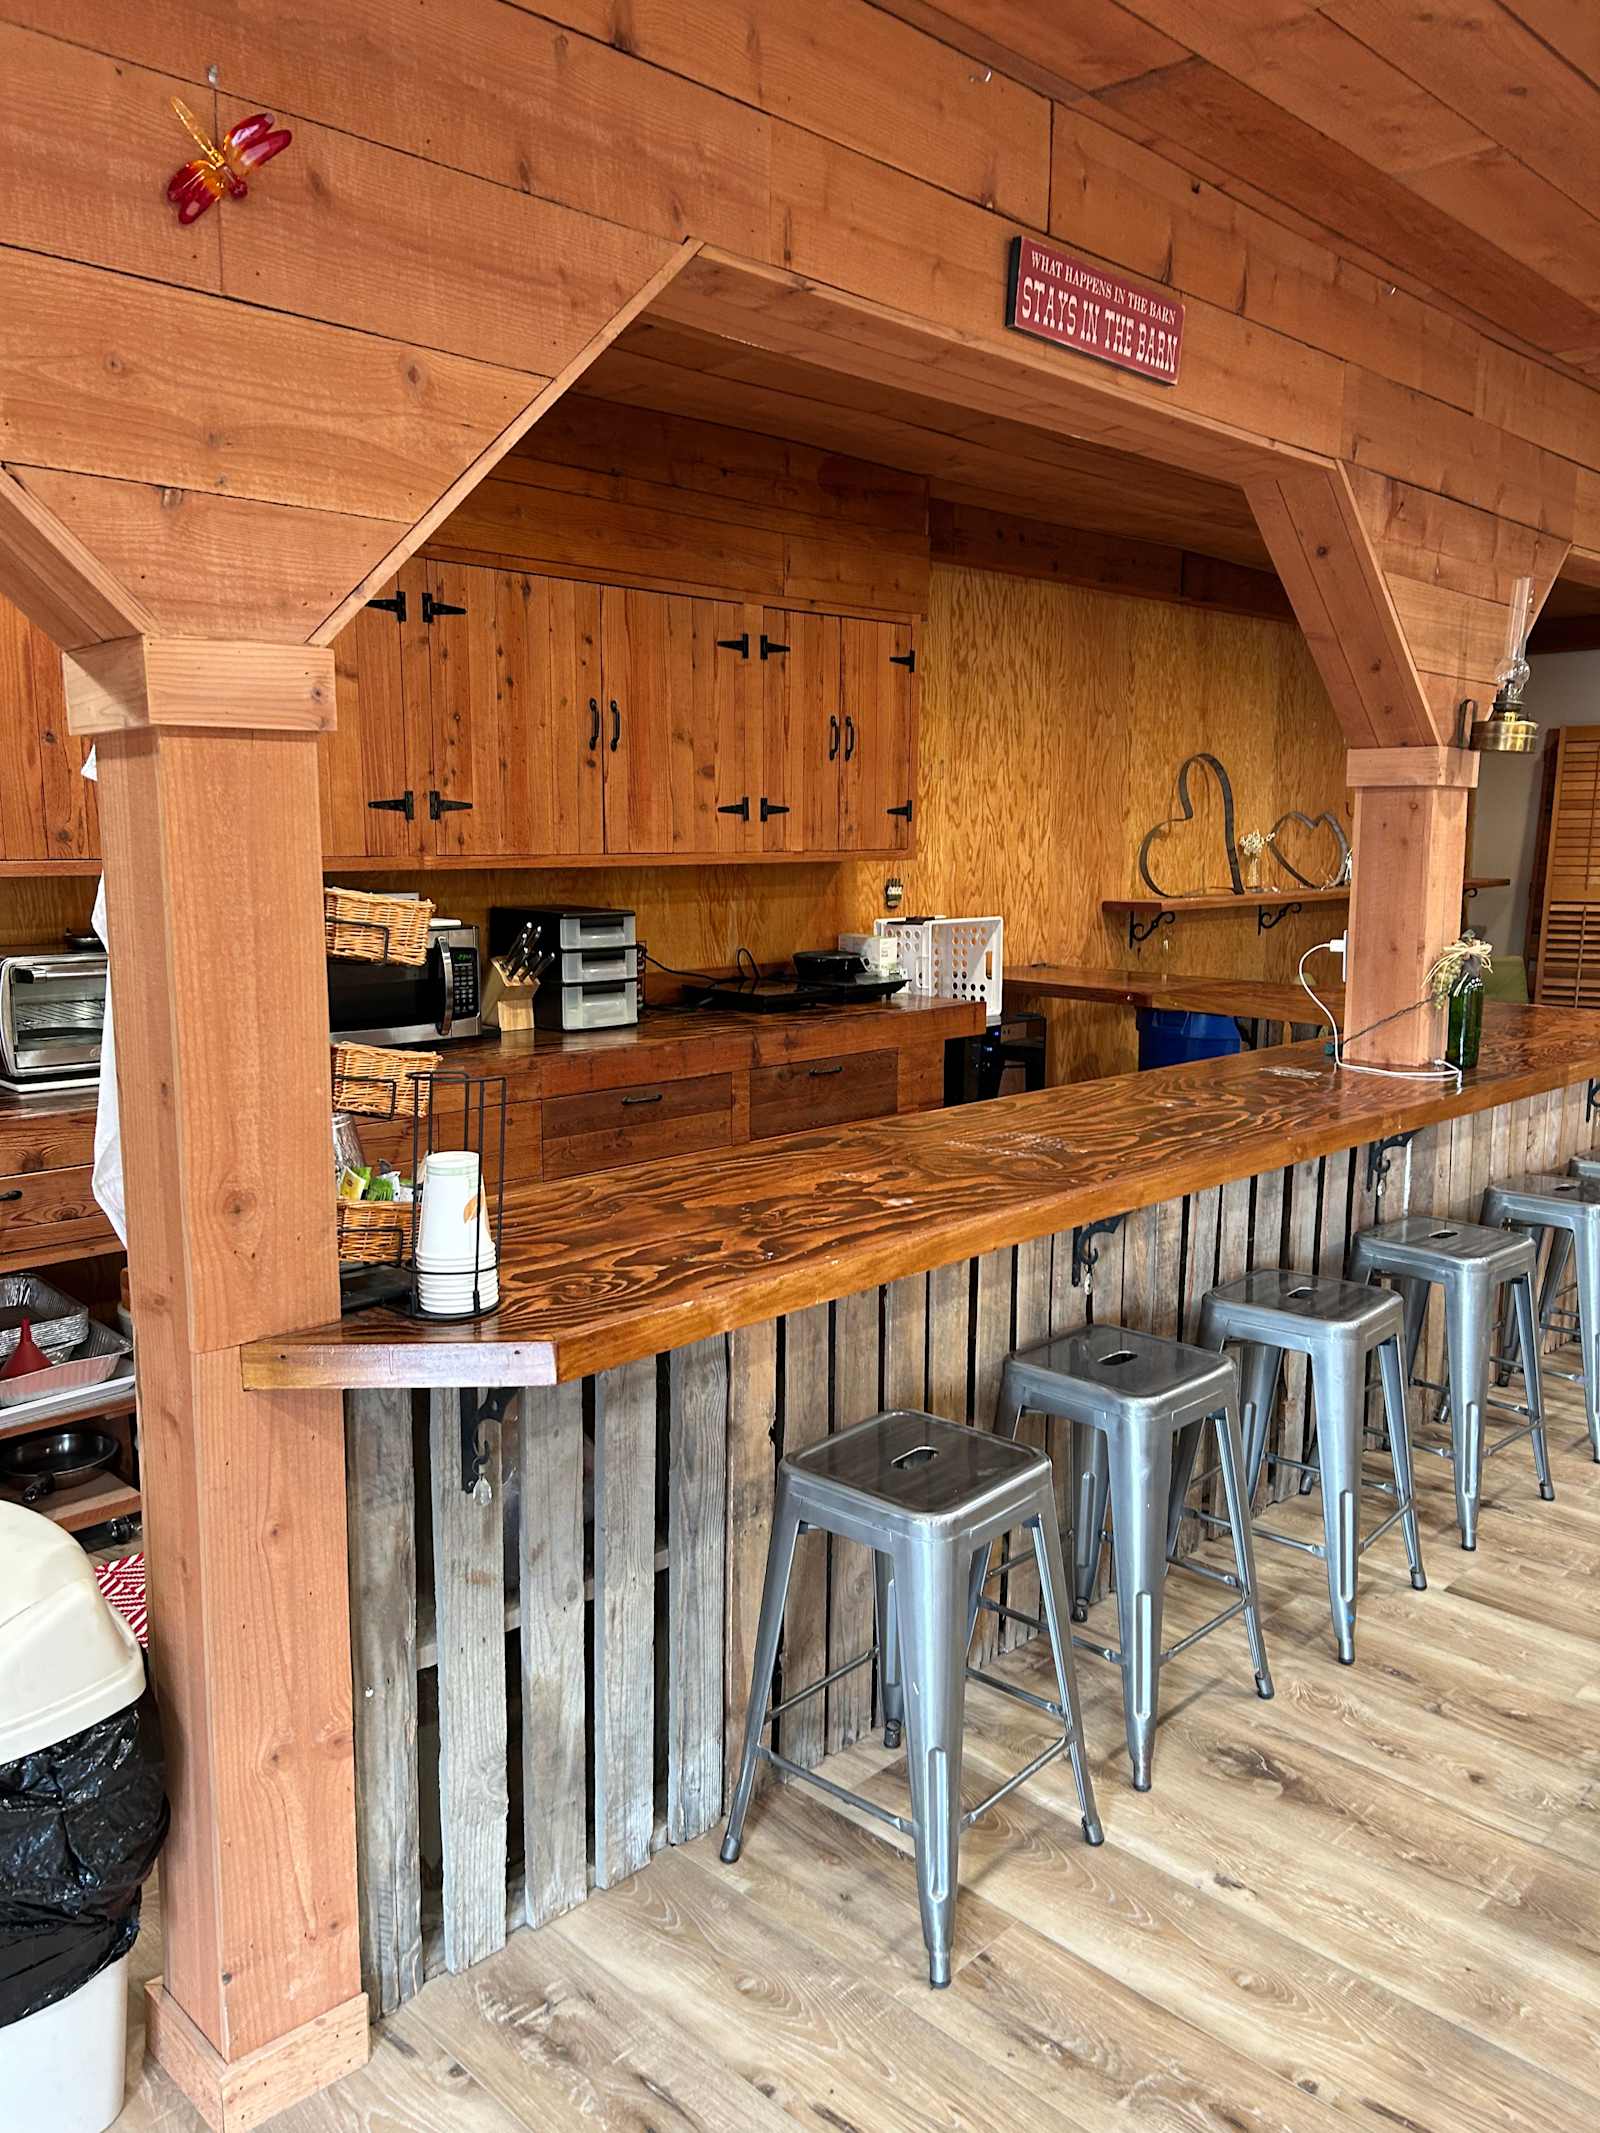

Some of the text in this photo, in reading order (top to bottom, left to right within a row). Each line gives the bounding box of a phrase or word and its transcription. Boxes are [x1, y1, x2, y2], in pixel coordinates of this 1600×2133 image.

[1021, 276, 1178, 374] STAYS IN THE BARN
[1031, 250, 1176, 326] WHAT HAPPENS IN THE BARN
